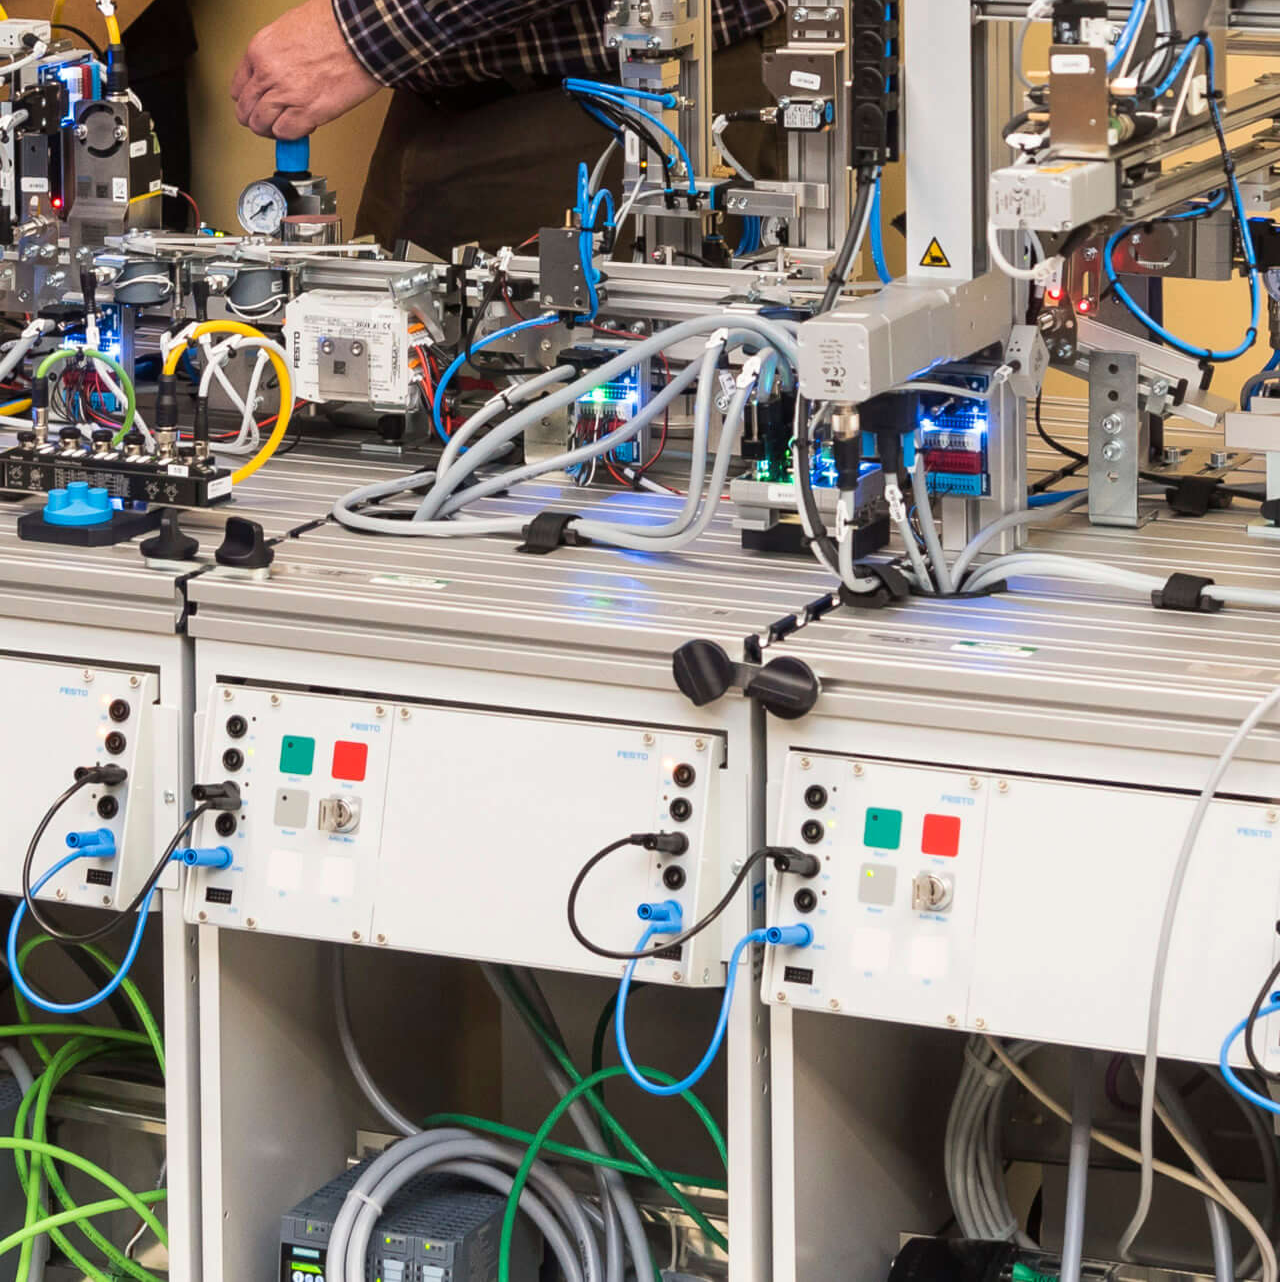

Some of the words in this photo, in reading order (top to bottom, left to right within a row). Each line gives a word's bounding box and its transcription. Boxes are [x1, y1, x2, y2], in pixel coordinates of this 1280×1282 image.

[293, 331, 301, 369] FESTO
[616, 749, 649, 761] FESTO
[1236, 826, 1273, 838] FESTO
